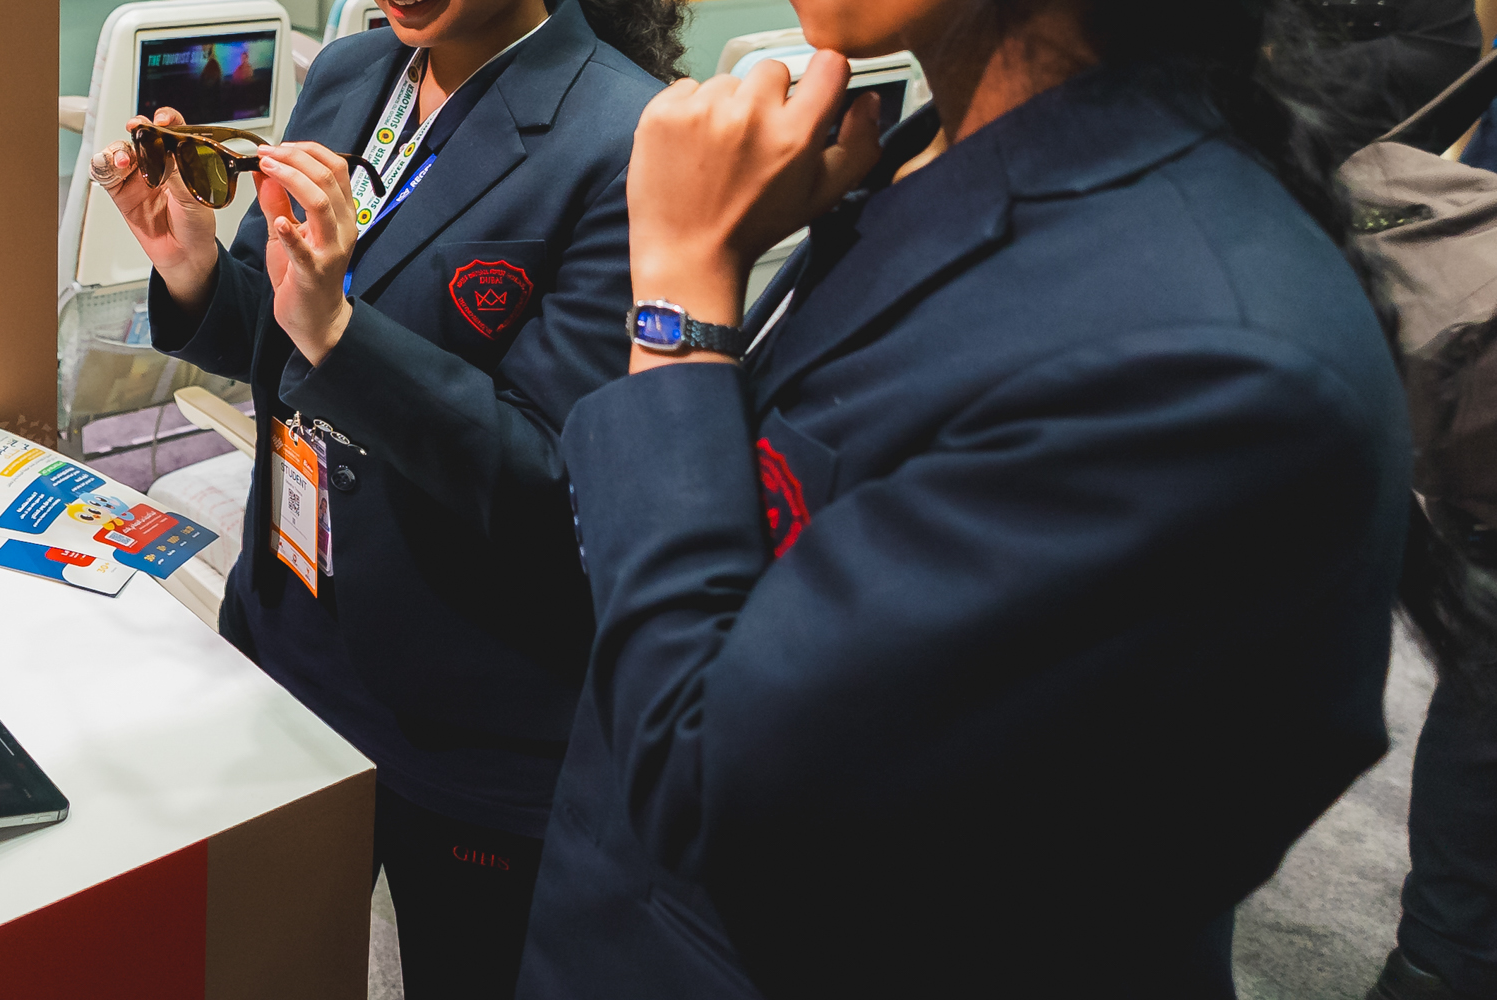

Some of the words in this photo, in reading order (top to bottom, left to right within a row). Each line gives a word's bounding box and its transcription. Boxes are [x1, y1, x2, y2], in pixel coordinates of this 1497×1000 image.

[390, 83, 414, 129] SUNFLOWER
[281, 462, 307, 490] STUDENT
[453, 845, 510, 871] GIHS
